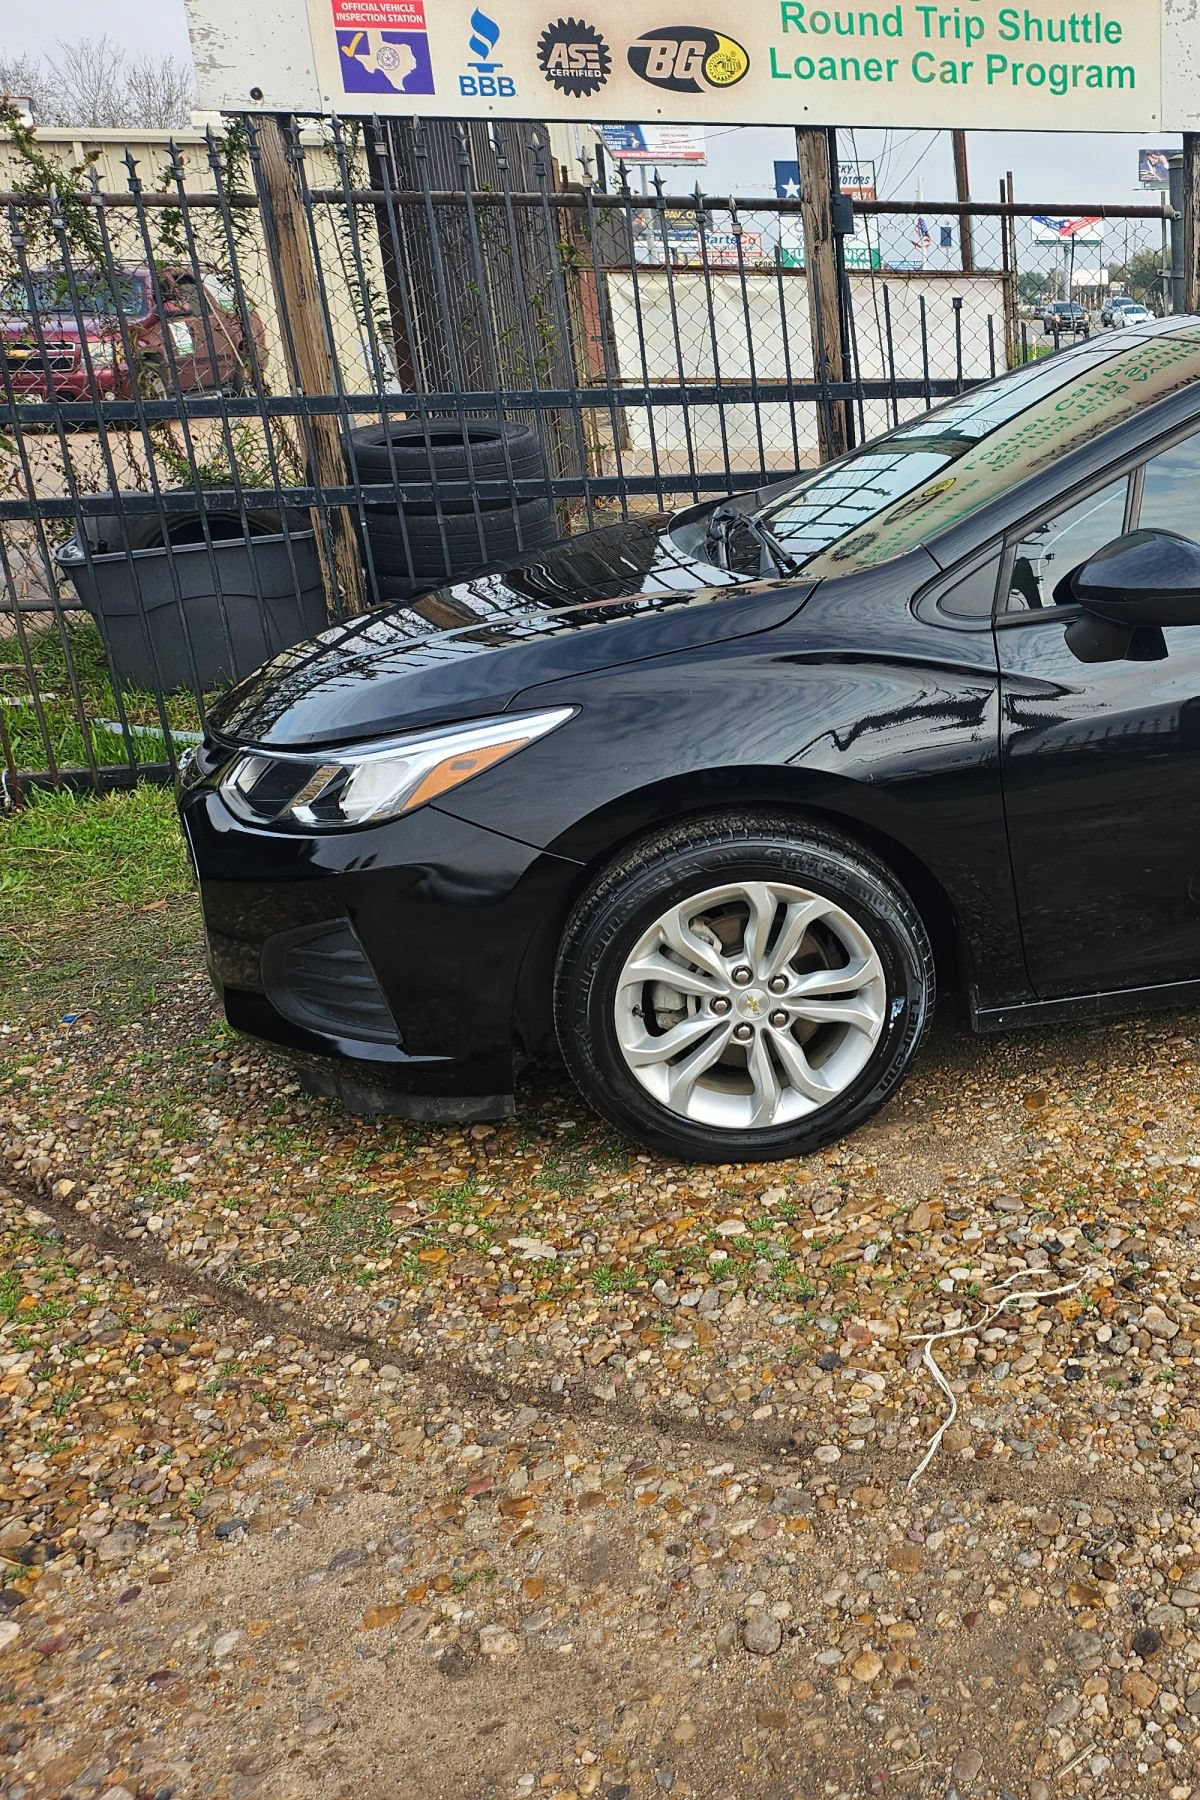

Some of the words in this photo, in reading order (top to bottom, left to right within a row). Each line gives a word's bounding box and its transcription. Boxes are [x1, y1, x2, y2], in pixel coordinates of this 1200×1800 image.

[336, 12, 387, 22] INSPECTION
[388, 14, 423, 23] STATION
[341, 3, 378, 12] OFFICIAL
[380, 4, 416, 13] VEHICLE
[780, 1, 903, 37] Round
[915, 6, 985, 48] Trip
[998, 9, 1122, 44] Shuttle
[547, 42, 599, 70] ASE
[646, 39, 707, 79] BG
[550, 69, 602, 78] CERTIFIED
[769, 47, 899, 82] Loaner
[912, 51, 974, 84] Car
[986, 53, 1135, 96] Program
[458, 75, 516, 97] BBB
